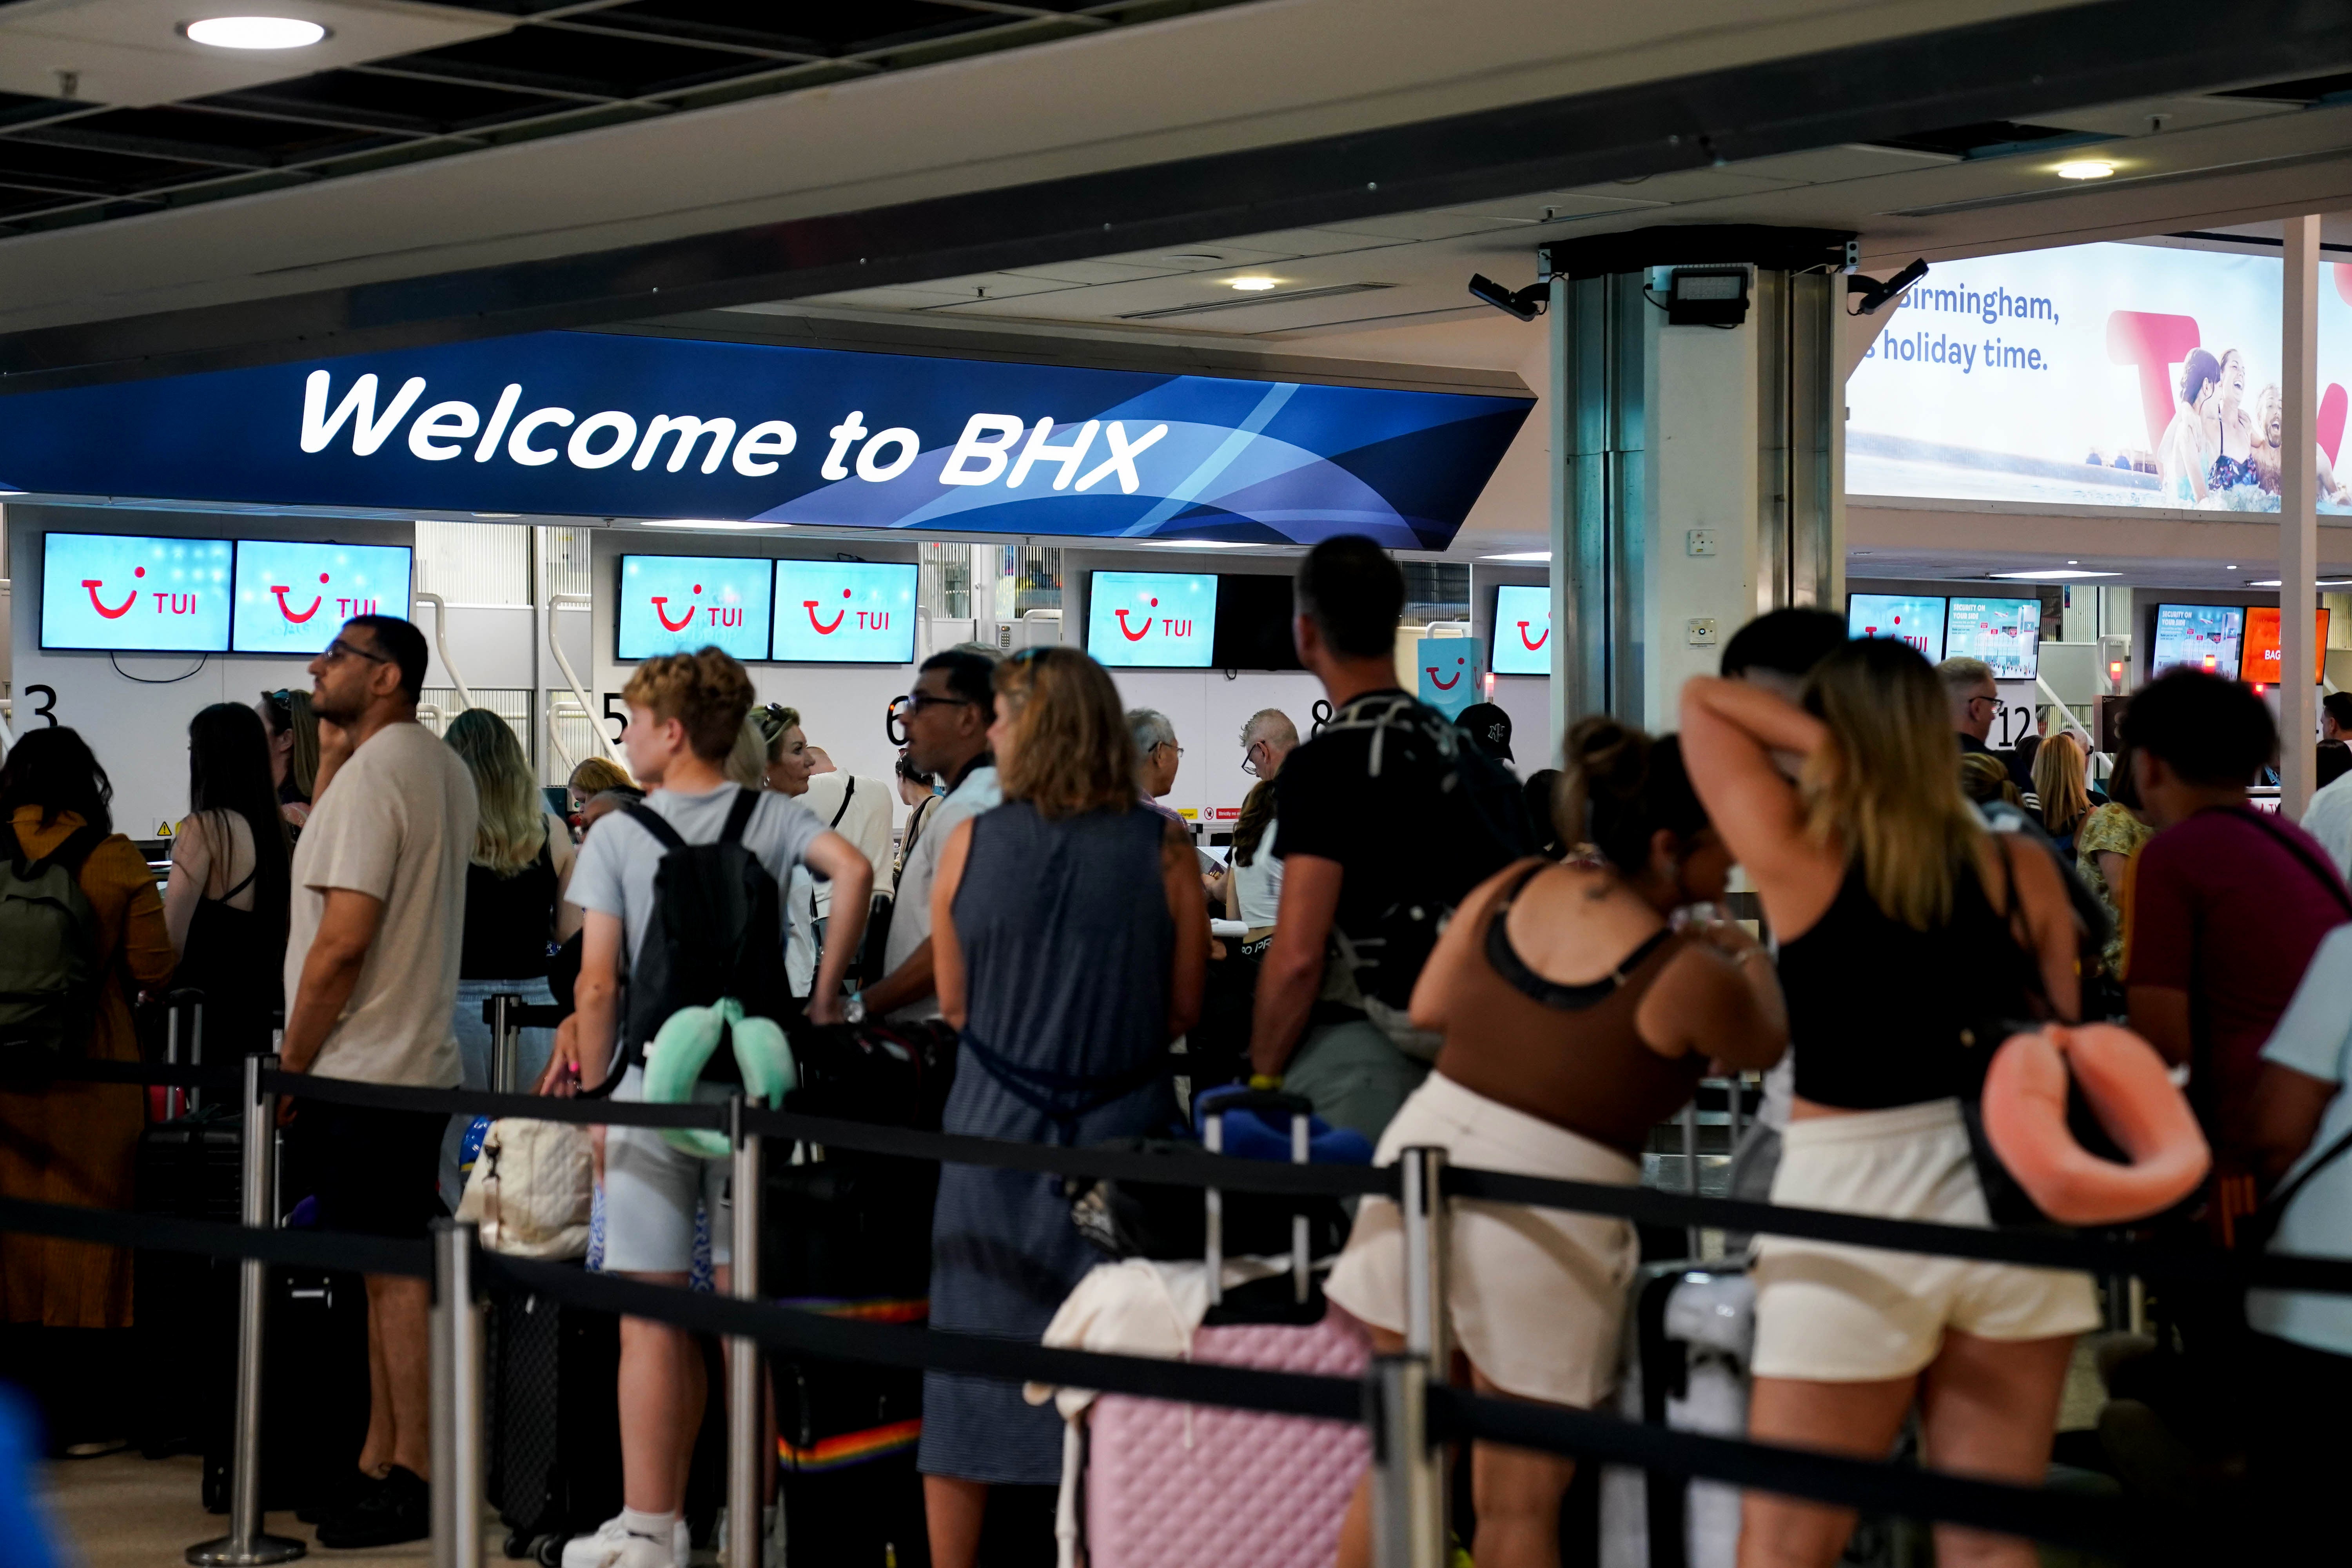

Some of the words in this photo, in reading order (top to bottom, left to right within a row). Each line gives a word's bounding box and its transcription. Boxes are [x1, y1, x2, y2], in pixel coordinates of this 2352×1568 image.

[1884, 330, 1976, 374] holiday
[1984, 338, 2047, 370] time.
[300, 370, 797, 477] Welcome
[821, 411, 920, 482] to
[939, 413, 1169, 494] BHX
[153, 593, 196, 614] TUI
[336, 598, 376, 618] TUI
[708, 608, 742, 627] TUI
[857, 612, 889, 630] TUI
[1162, 619, 1192, 637] TUI
[25, 684, 58, 727] 3
[604, 693, 628, 745] 5
[887, 696, 909, 746] 6
[1311, 700, 1332, 740] 8
[1999, 707, 2030, 747] 12
